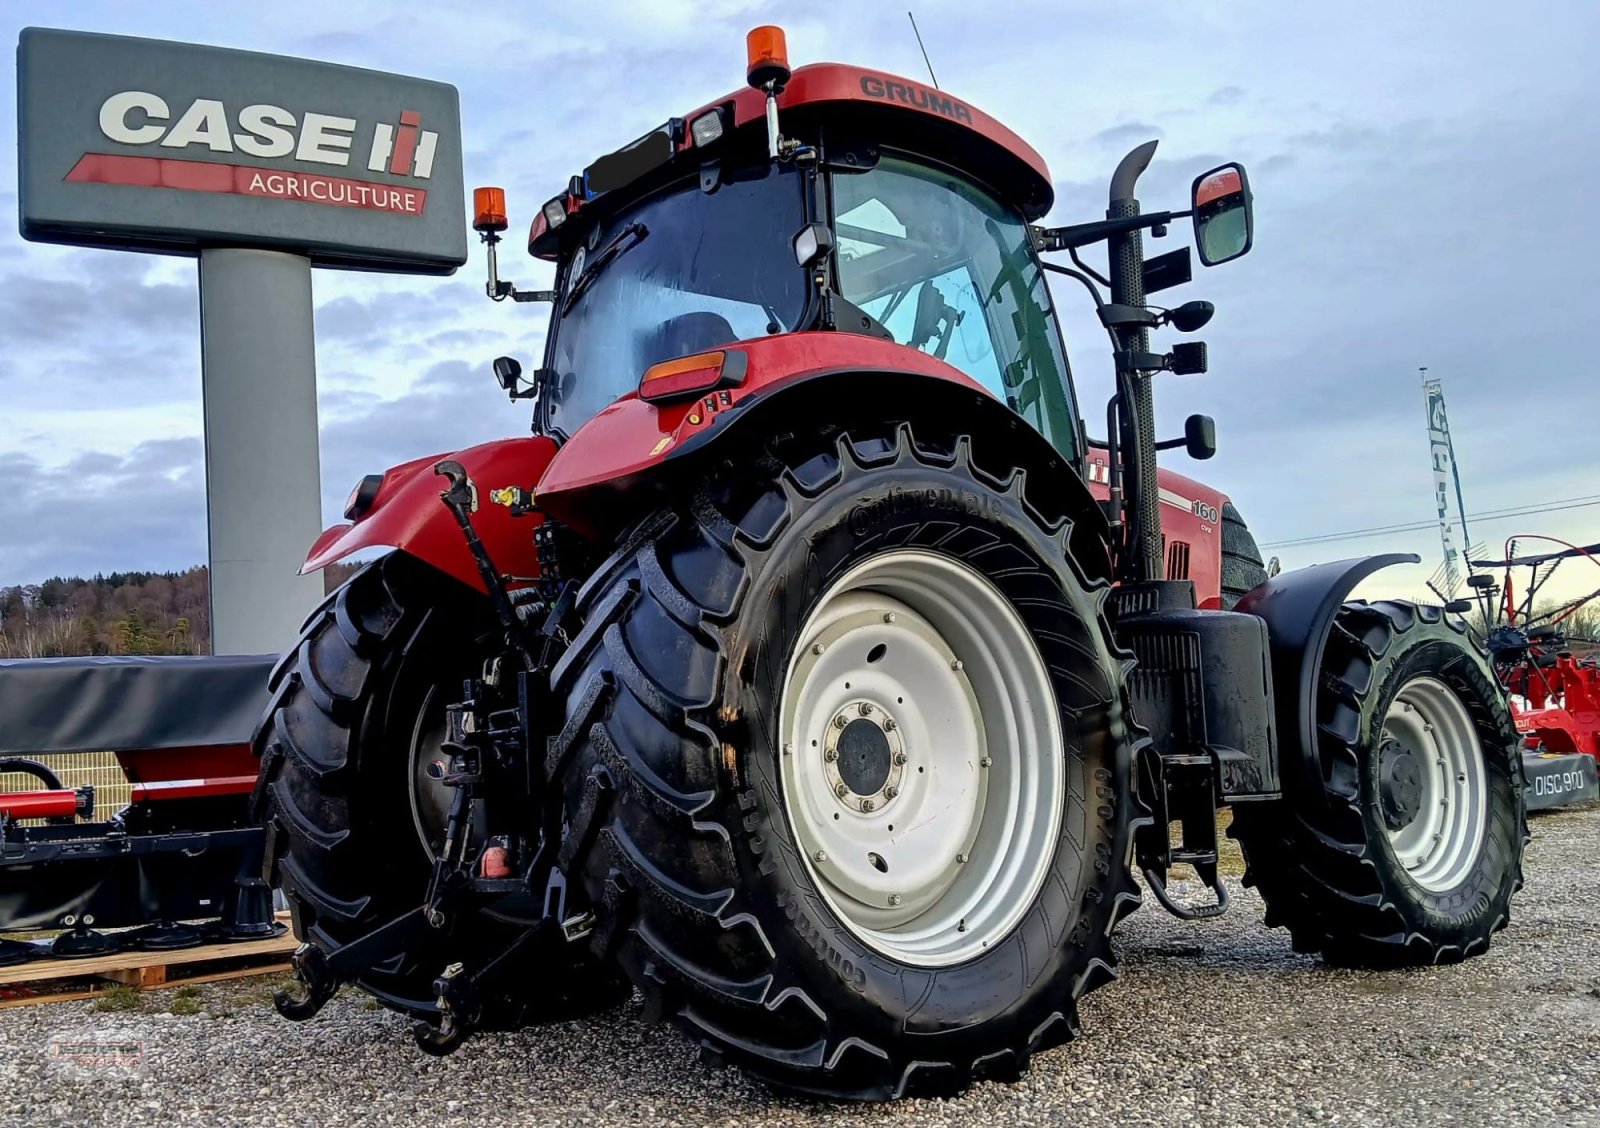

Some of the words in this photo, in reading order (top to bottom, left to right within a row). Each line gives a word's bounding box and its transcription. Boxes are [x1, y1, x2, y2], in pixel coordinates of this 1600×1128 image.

[860, 75, 973, 126] GRUMA
[99, 91, 357, 166] CASE
[248, 172, 416, 212] AGRICULTURE
[1192, 499, 1219, 525] 160
[1535, 773, 1563, 796] DISC
